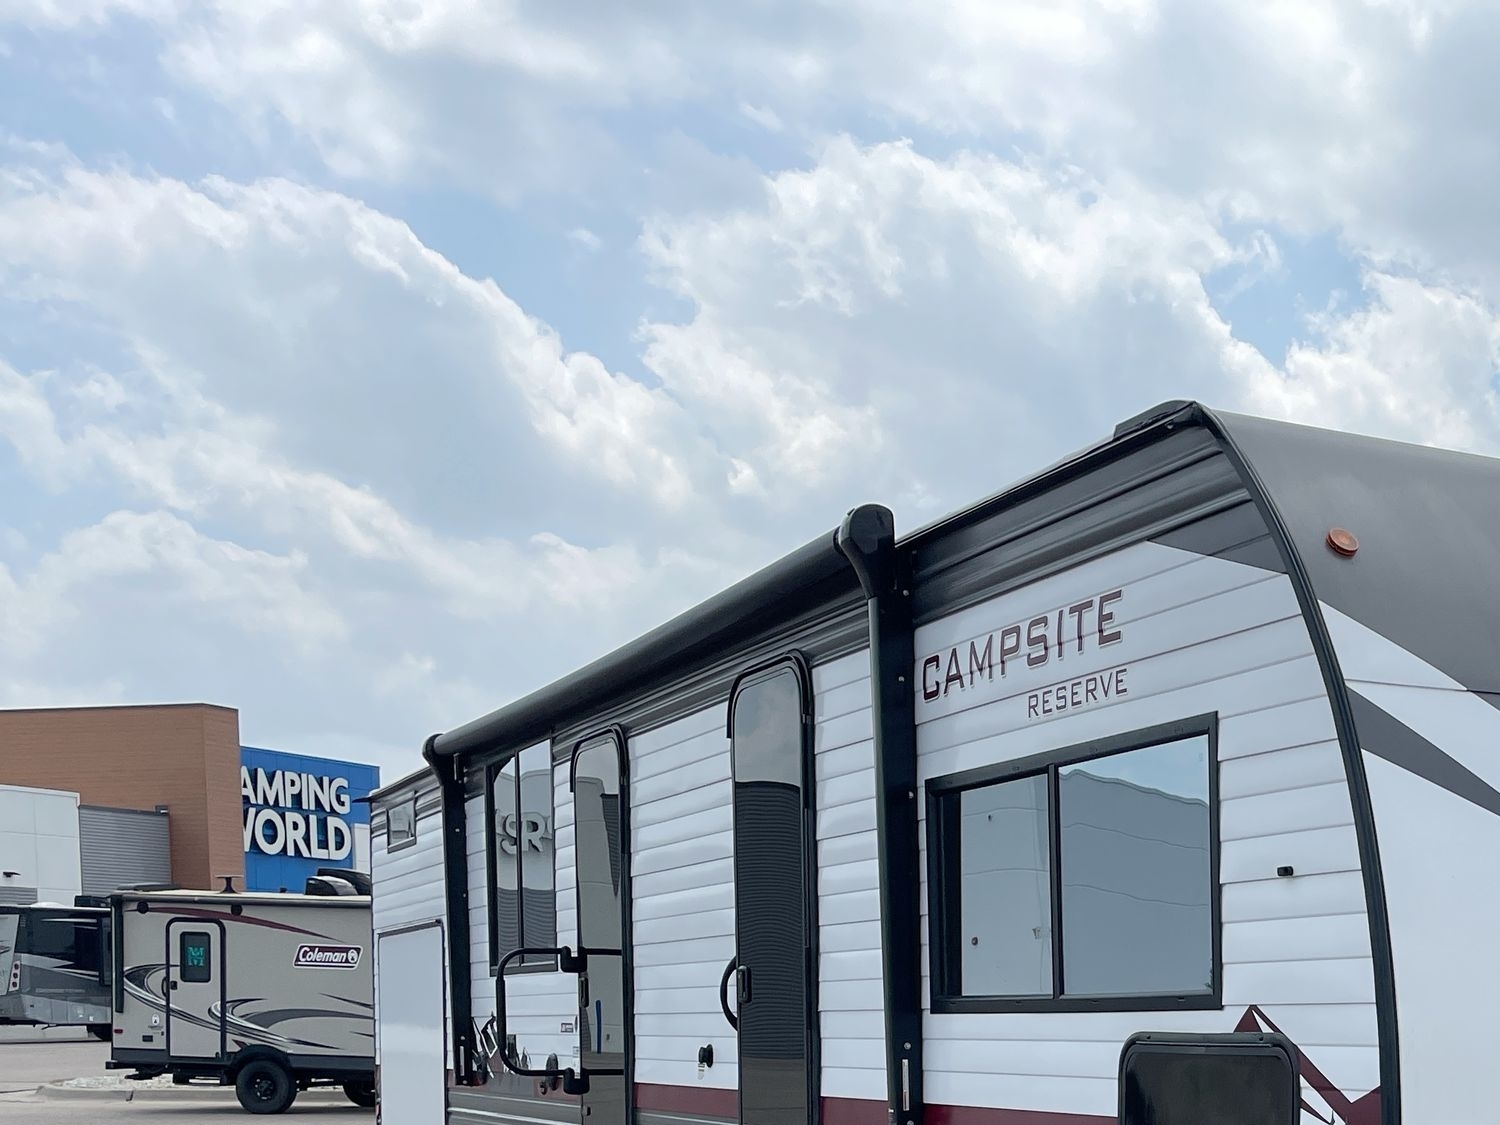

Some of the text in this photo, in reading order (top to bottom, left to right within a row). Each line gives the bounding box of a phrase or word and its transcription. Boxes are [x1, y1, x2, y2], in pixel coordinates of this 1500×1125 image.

[922, 589, 1124, 702] CAMPSITE
[1027, 668, 1129, 718] RESERVE
[240, 765, 351, 814] AMPING
[299, 946, 347, 963] Coleman
